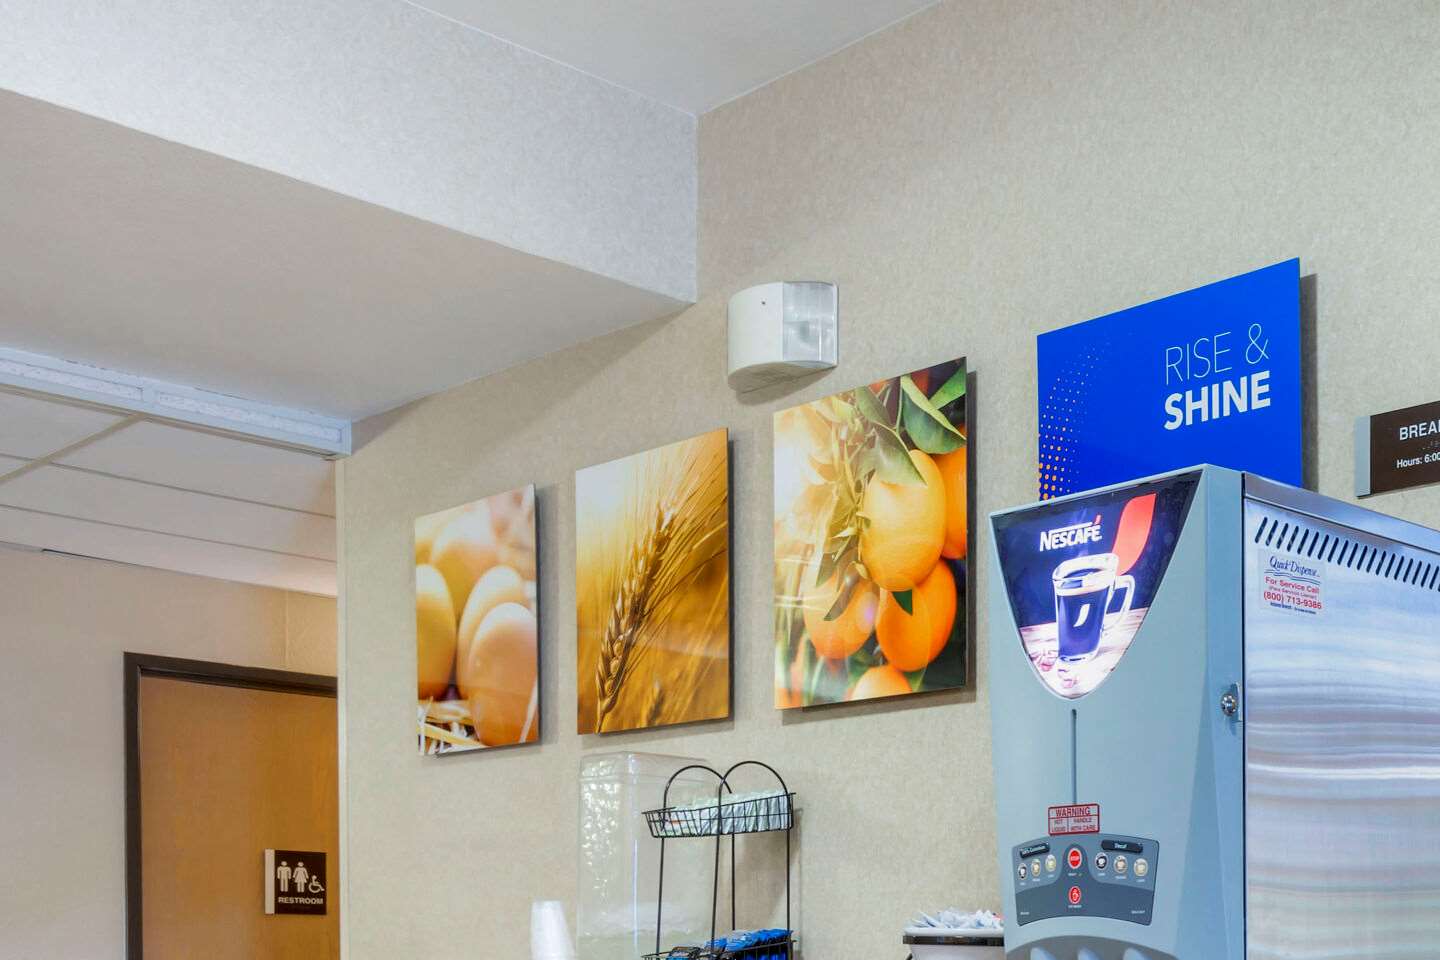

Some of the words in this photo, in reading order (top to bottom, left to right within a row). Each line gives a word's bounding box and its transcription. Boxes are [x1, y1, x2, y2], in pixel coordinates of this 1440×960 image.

[1166, 331, 1233, 386] RISE
[1245, 323, 1269, 365] &
[1164, 370, 1271, 431] SHINE
[1396, 456, 1423, 469] Hours:
[1040, 515, 1103, 552] NESCAFÉ
[1265, 576, 1277, 585] For
[1279, 580, 1305, 591] Service
[1306, 585, 1320, 594] Call
[1264, 591, 1284, 604] (800)
[1056, 807, 1091, 817] WARNING
[278, 896, 324, 904] RESTROOM
